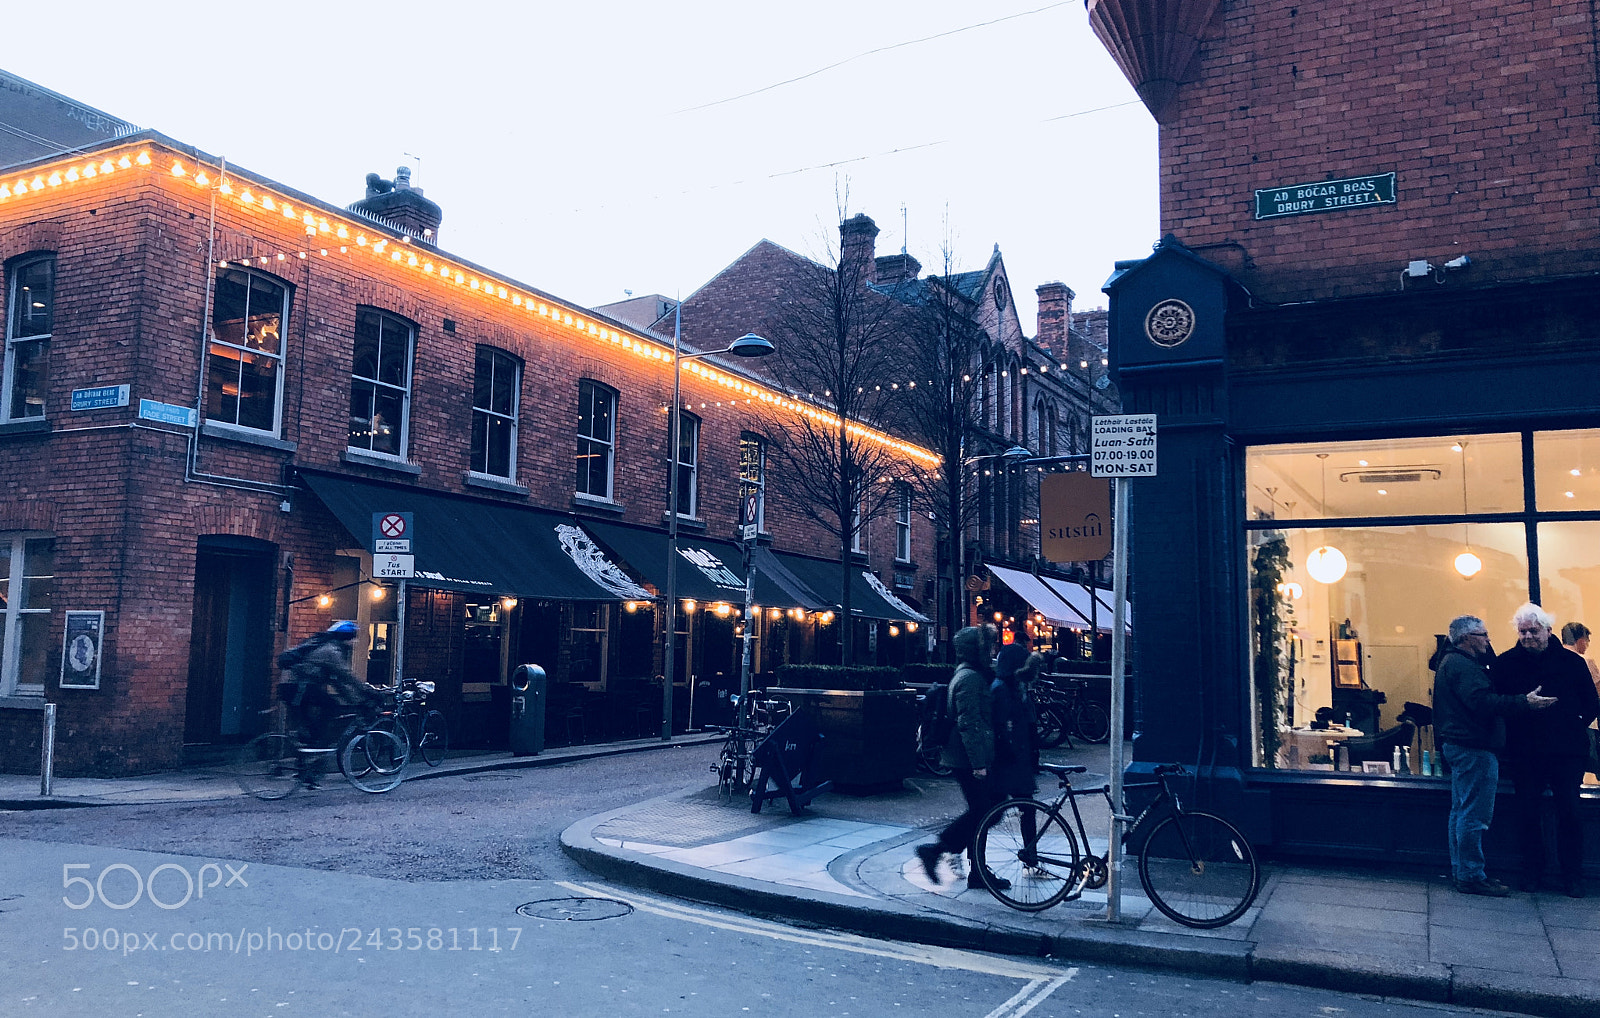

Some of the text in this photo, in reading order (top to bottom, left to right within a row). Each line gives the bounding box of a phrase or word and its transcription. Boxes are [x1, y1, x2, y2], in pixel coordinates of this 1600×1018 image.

[1277, 200, 1315, 213] DRURY
[73, 397, 118, 408] DRURY STREET
[143, 409, 186, 423] FADE STREET
[1094, 425, 1153, 434] LOADING BAY
[1094, 436, 1154, 447] Luan-Sath
[1094, 449, 1155, 461] 07.00-19.00
[1094, 463, 1154, 474] MON-SAT
[1049, 517, 1102, 539] sitstil
